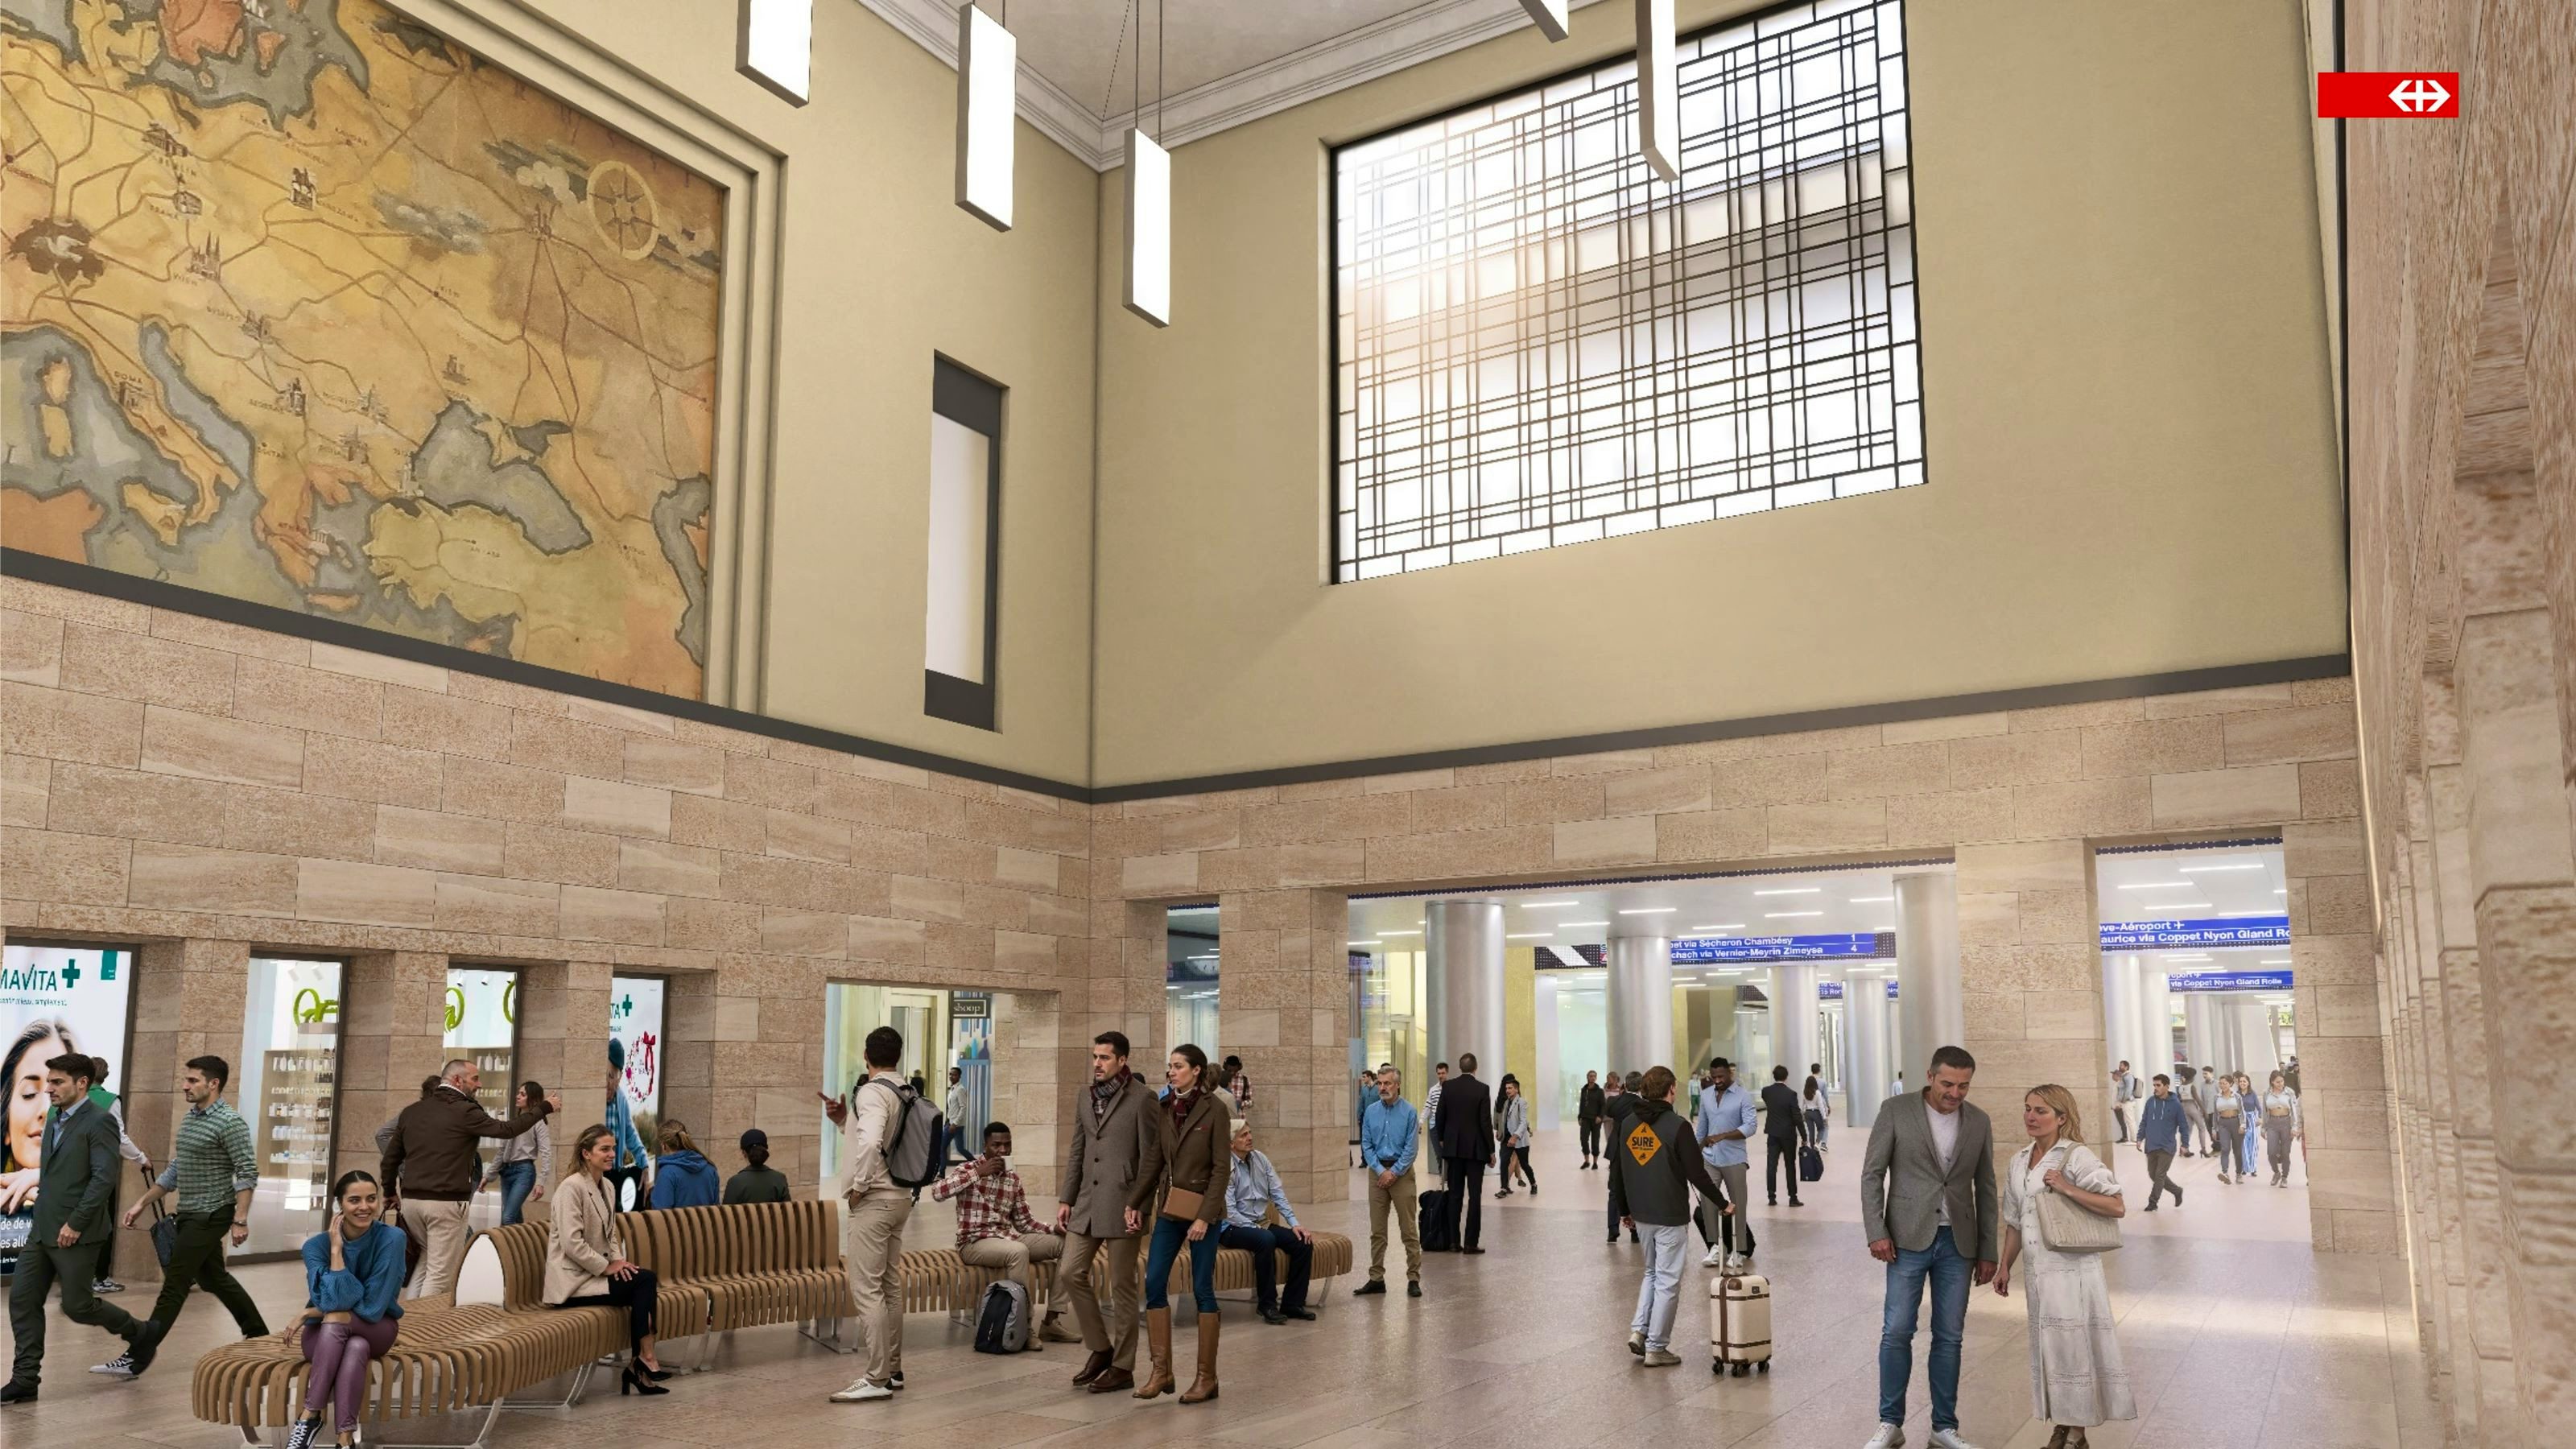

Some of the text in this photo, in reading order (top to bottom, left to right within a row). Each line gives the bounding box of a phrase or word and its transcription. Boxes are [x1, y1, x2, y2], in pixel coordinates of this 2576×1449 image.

[1685, 940, 1697, 948] via
[1851, 934, 1856, 942] 1
[2138, 934, 2155, 942] via
[2158, 932, 2201, 943] Coppet
[2204, 931, 2234, 941] Nyon
[2237, 929, 2273, 939] Gland
[1715, 947, 1781, 958] Vernier-Meyrin
[1851, 944, 1857, 952] 4
[2214, 979, 2235, 987] Nyon
[1632, 1136, 1653, 1147] SURE
[14, 1217, 24, 1229] de
